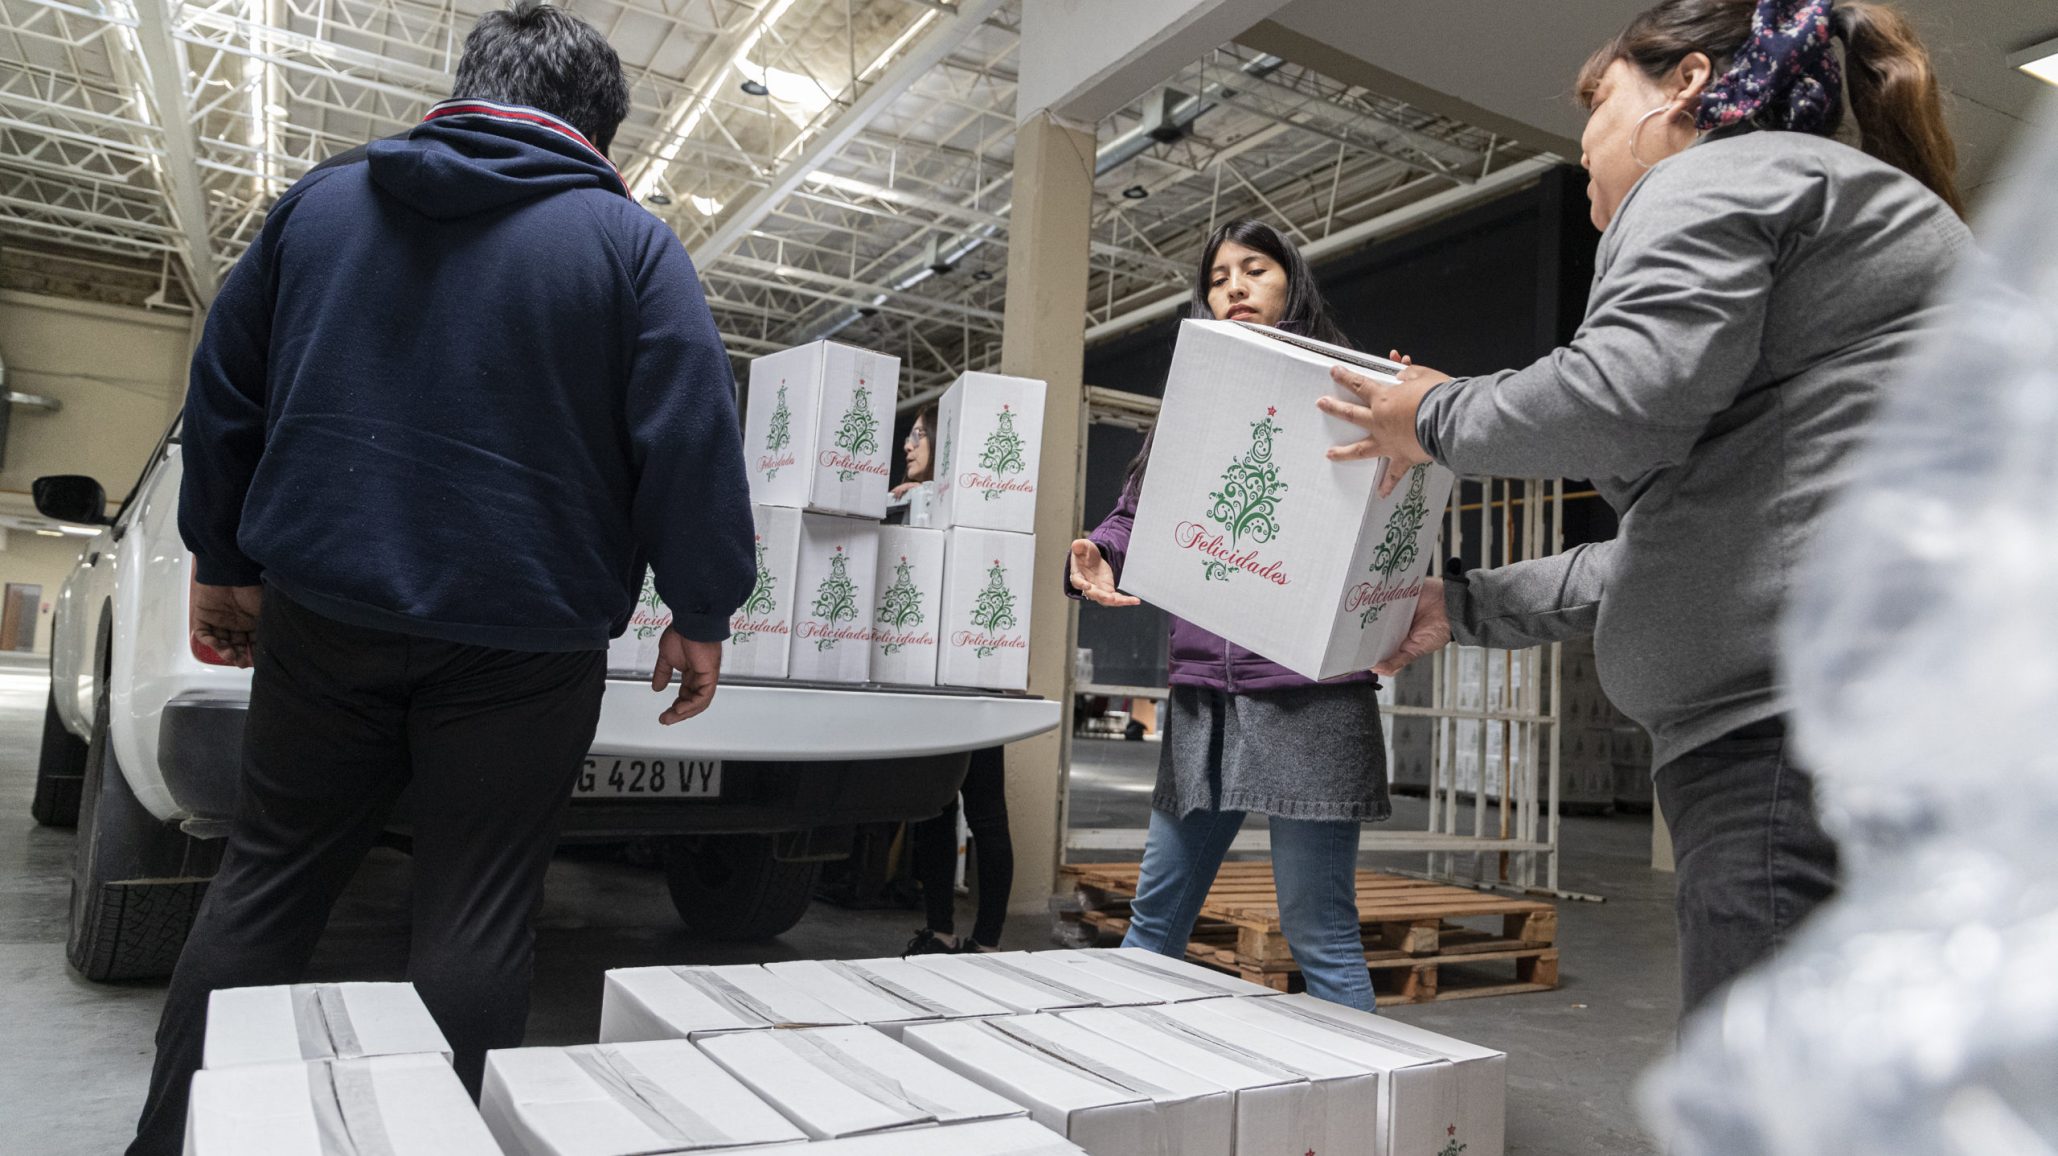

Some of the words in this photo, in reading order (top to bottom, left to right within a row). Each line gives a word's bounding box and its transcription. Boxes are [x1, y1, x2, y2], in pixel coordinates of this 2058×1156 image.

[756, 452, 795, 473] Felicidades
[819, 450, 889, 476] Felicidades
[959, 472, 1036, 493] Felicidades
[1175, 521, 1291, 585] Felicidades
[1344, 576, 1422, 612] Felicidades
[628, 610, 673, 627] elicida
[729, 615, 791, 634] elicidades
[796, 621, 870, 641] Felicidades
[951, 630, 1028, 649] Felicidades
[608, 760, 666, 793] 428
[678, 760, 714, 793] VY
